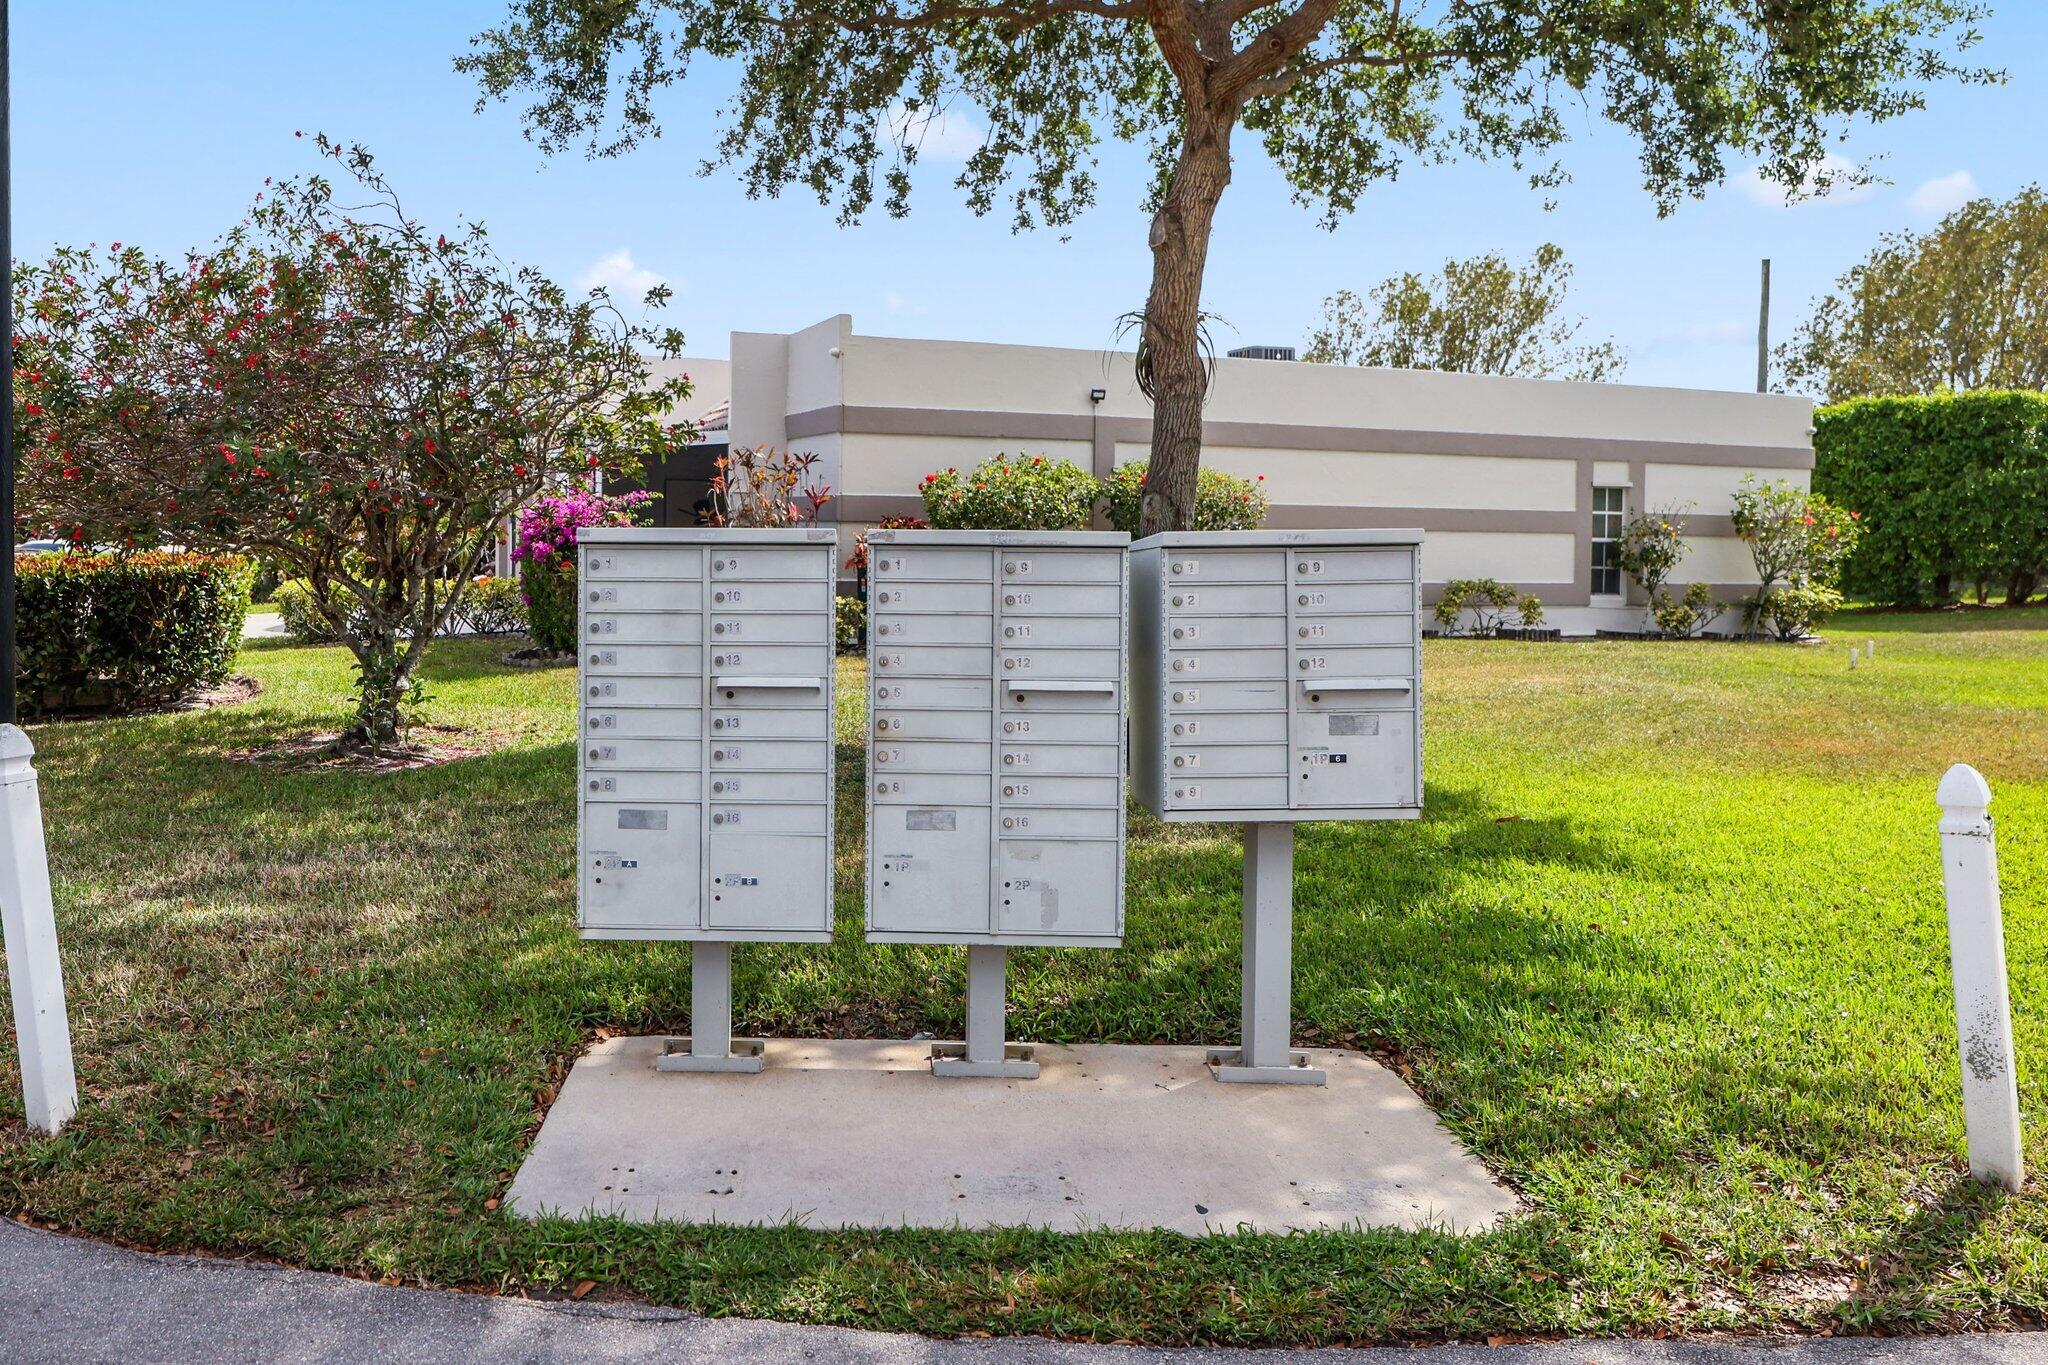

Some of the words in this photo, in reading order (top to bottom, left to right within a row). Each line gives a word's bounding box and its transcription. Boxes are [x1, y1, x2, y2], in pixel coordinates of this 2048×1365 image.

[729, 559, 737, 570] 9
[895, 559, 900, 570] 1
[1021, 562, 1028, 572] 9
[1313, 562, 1321, 573] 9
[726, 591, 741, 601] 10
[894, 592, 901, 602] 2
[1016, 594, 1031, 604] 10
[1188, 595, 1195, 605] 2
[1309, 593, 1325, 604] 10
[726, 622, 740, 632] 11
[894, 623, 901, 633] 3
[1018, 625, 1031, 636] 11
[1188, 627, 1196, 637] 3
[1311, 625, 1325, 636] 11
[726, 654, 741, 665] 12
[893, 656, 901, 666] 4
[1016, 657, 1031, 668] 12
[1188, 659, 1196, 670] 4
[1311, 657, 1325, 668] 12
[894, 688, 901, 698] 5
[1188, 690, 1196, 701] 5
[604, 716, 612, 727] 6
[726, 717, 739, 728] 13
[893, 719, 900, 729] 6
[1016, 721, 1030, 732] 13
[1188, 722, 1196, 734] 6
[604, 748, 611, 759] 7
[726, 750, 740, 760] 14
[893, 750, 900, 760] 7
[1016, 753, 1030, 764] 14
[1188, 755, 1196, 766] 7
[1335, 755, 1341, 763] 6
[604, 780, 611, 790] 8
[726, 781, 739, 791] 15
[892, 782, 900, 792] 8
[1015, 785, 1029, 795] 15
[725, 813, 740, 823] 16
[1014, 817, 1029, 827] 16
[746, 877, 752, 885] B
[1014, 880, 1031, 890] 2P
